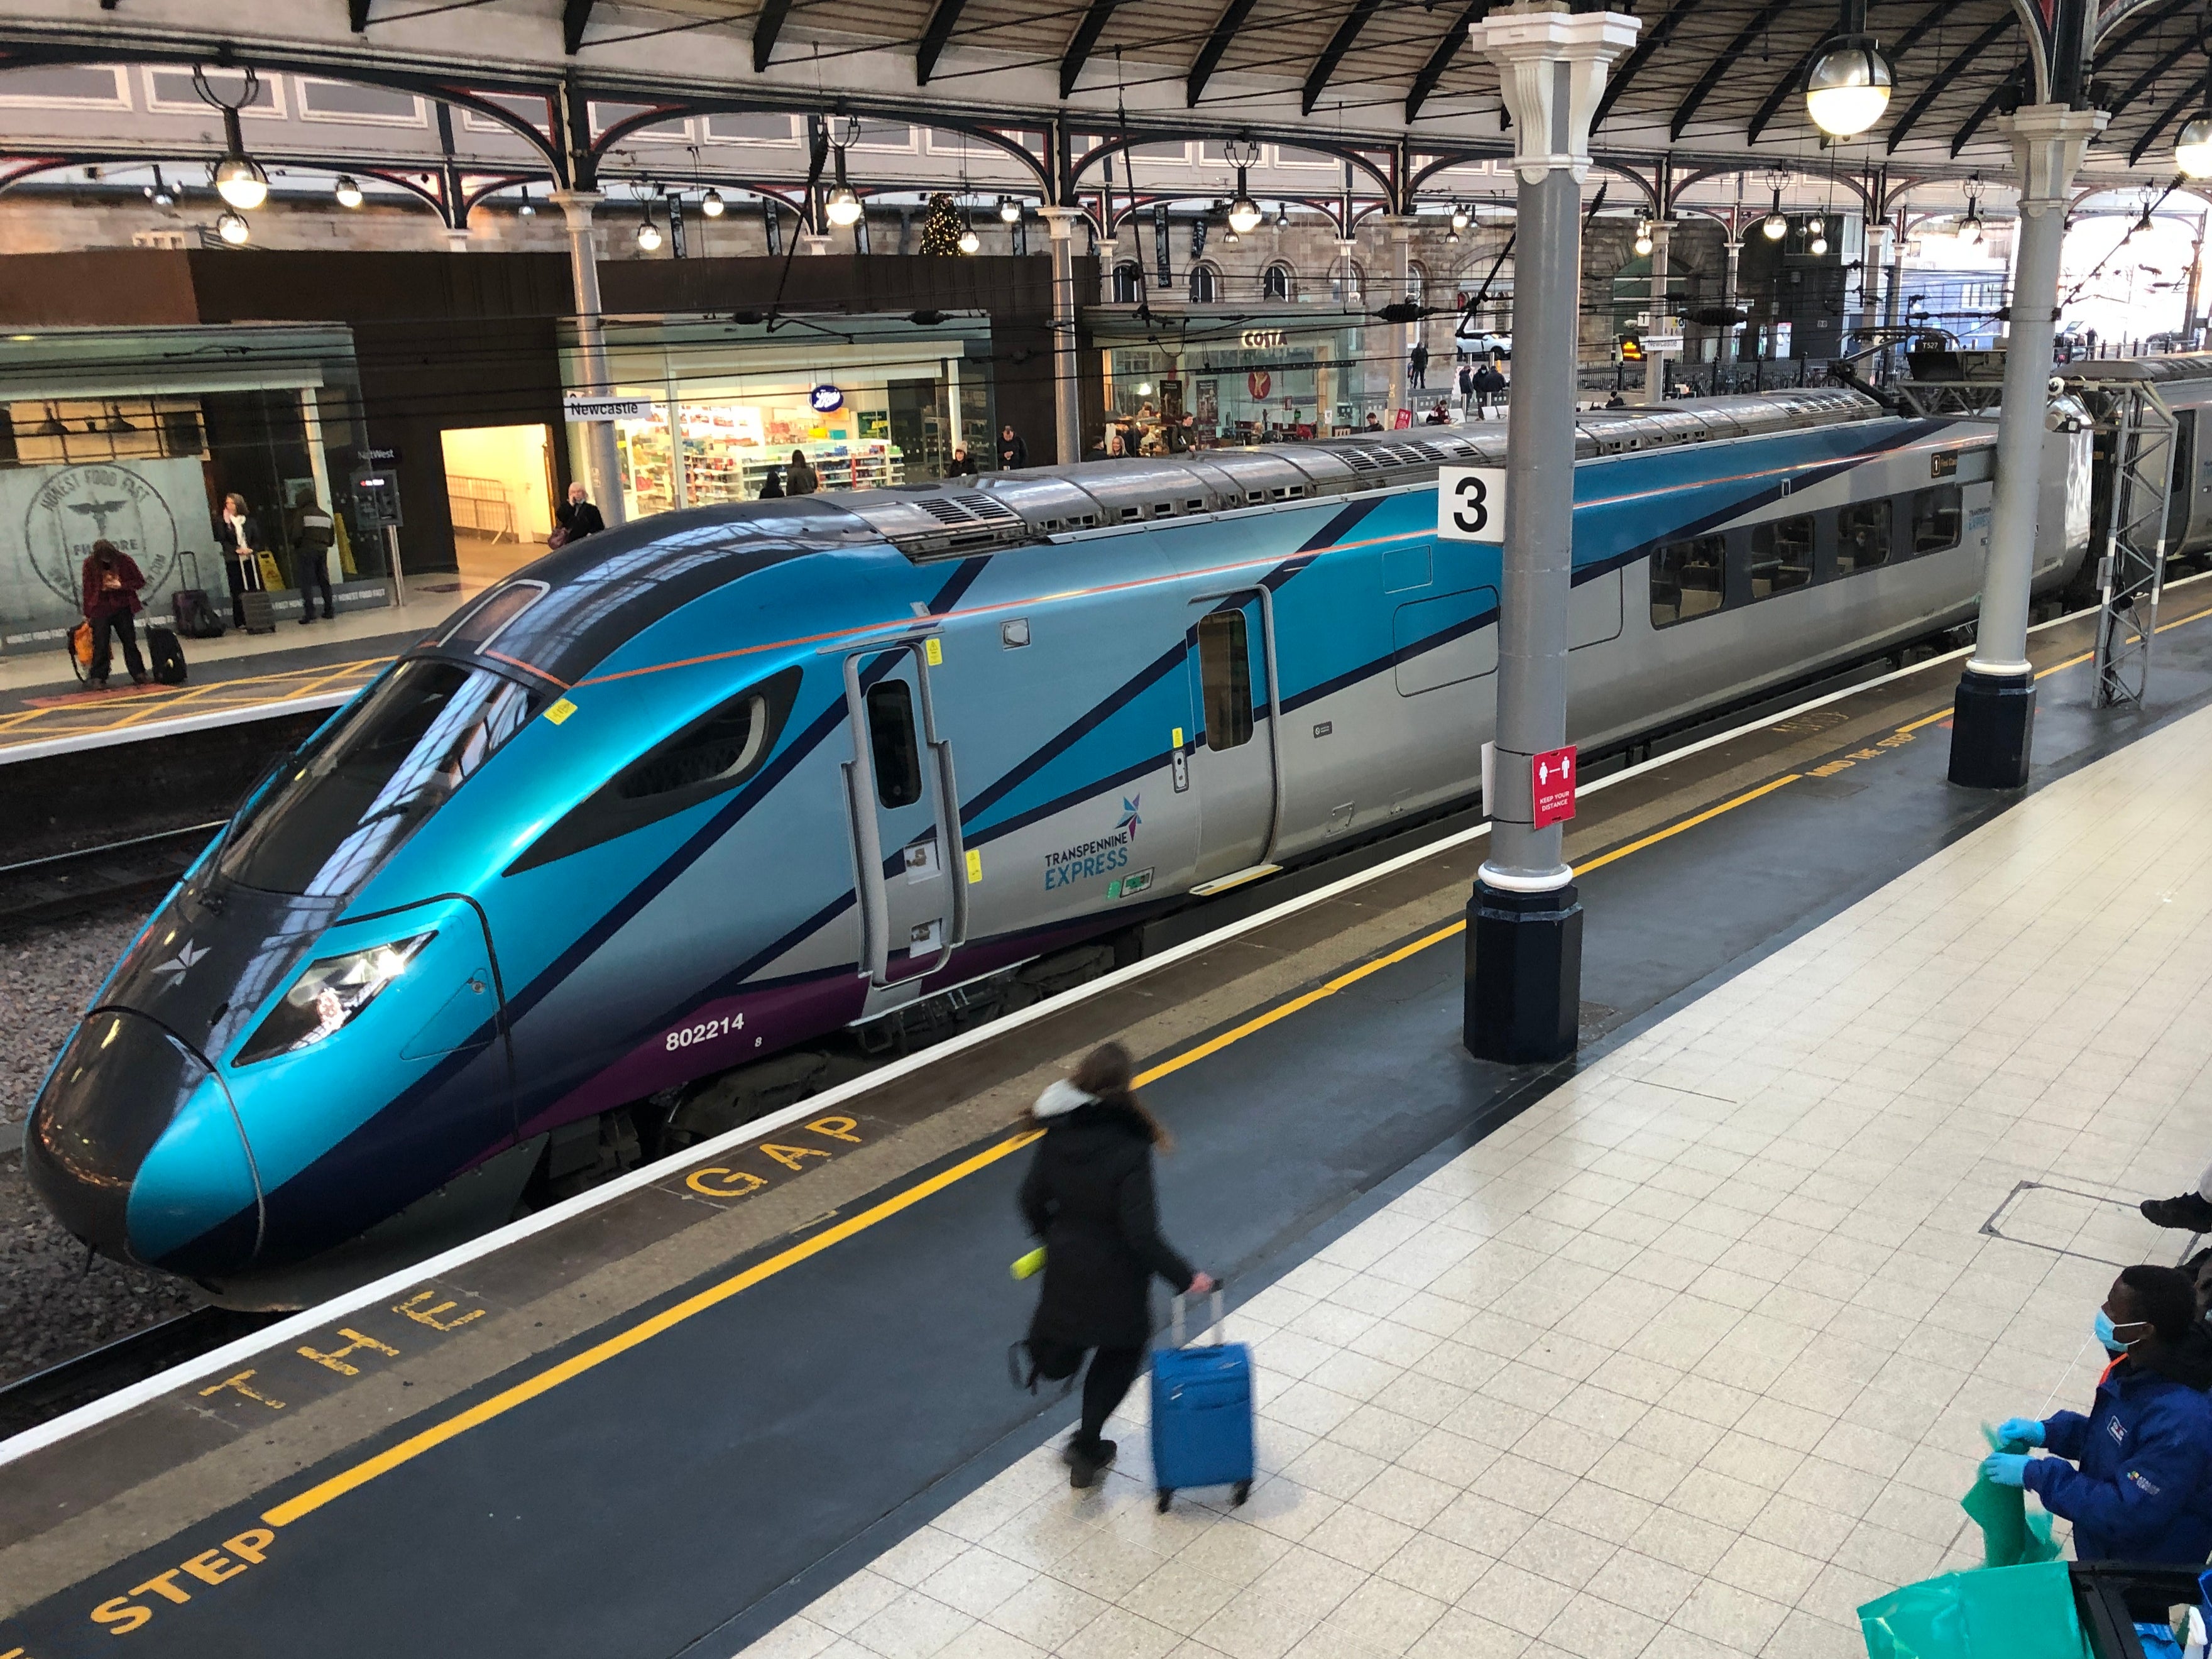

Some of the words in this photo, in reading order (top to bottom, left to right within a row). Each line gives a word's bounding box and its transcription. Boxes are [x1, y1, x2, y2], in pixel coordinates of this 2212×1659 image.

[1244, 332, 1288, 348] COSTA
[1648, 339, 1678, 348] Newcastle
[571, 402, 638, 415] Newcastle
[357, 449, 395, 460] NatWest
[84, 469, 117, 487] FOOD
[119, 476, 150, 503] FAST
[1453, 476, 1487, 533] 3
[1876, 733, 1917, 748] STEP
[1540, 795, 1553, 804] KEEP
[1555, 791, 1570, 799] YOUR
[1541, 799, 1568, 812] DISTANCE
[1045, 831, 1128, 867] TRANSPENNINE
[1045, 846, 1128, 891] EXPRESS
[665, 1012, 745, 1051] 802214
[755, 1036, 762, 1048] 8
[198, 1290, 486, 1410] THE
[686, 1116, 863, 1196] GAP
[90, 1528, 275, 1635] STEP
